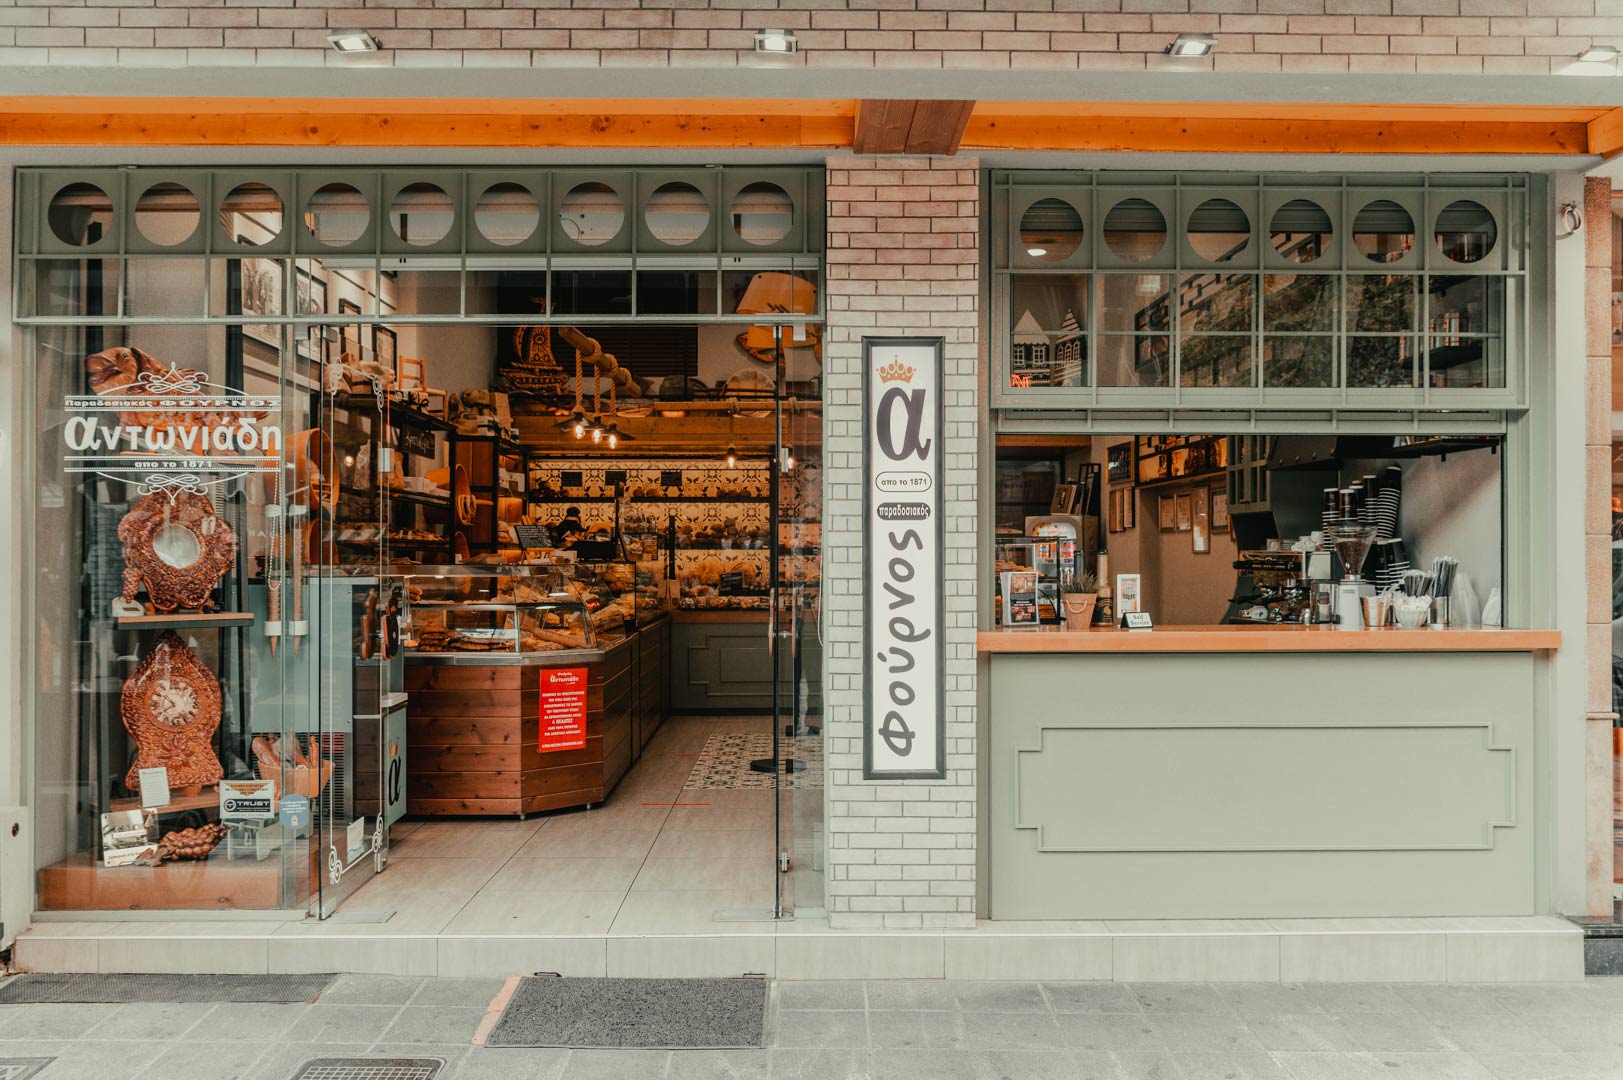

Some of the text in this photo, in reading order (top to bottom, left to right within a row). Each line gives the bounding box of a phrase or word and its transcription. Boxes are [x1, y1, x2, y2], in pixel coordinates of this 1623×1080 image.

[65, 400, 153, 408] Παραδοσιακός
[181, 460, 213, 468] 1871
[910, 478, 927, 486] 1871
[878, 504, 929, 519] παραδοσιακός
[877, 529, 931, 757] Φούρνος
